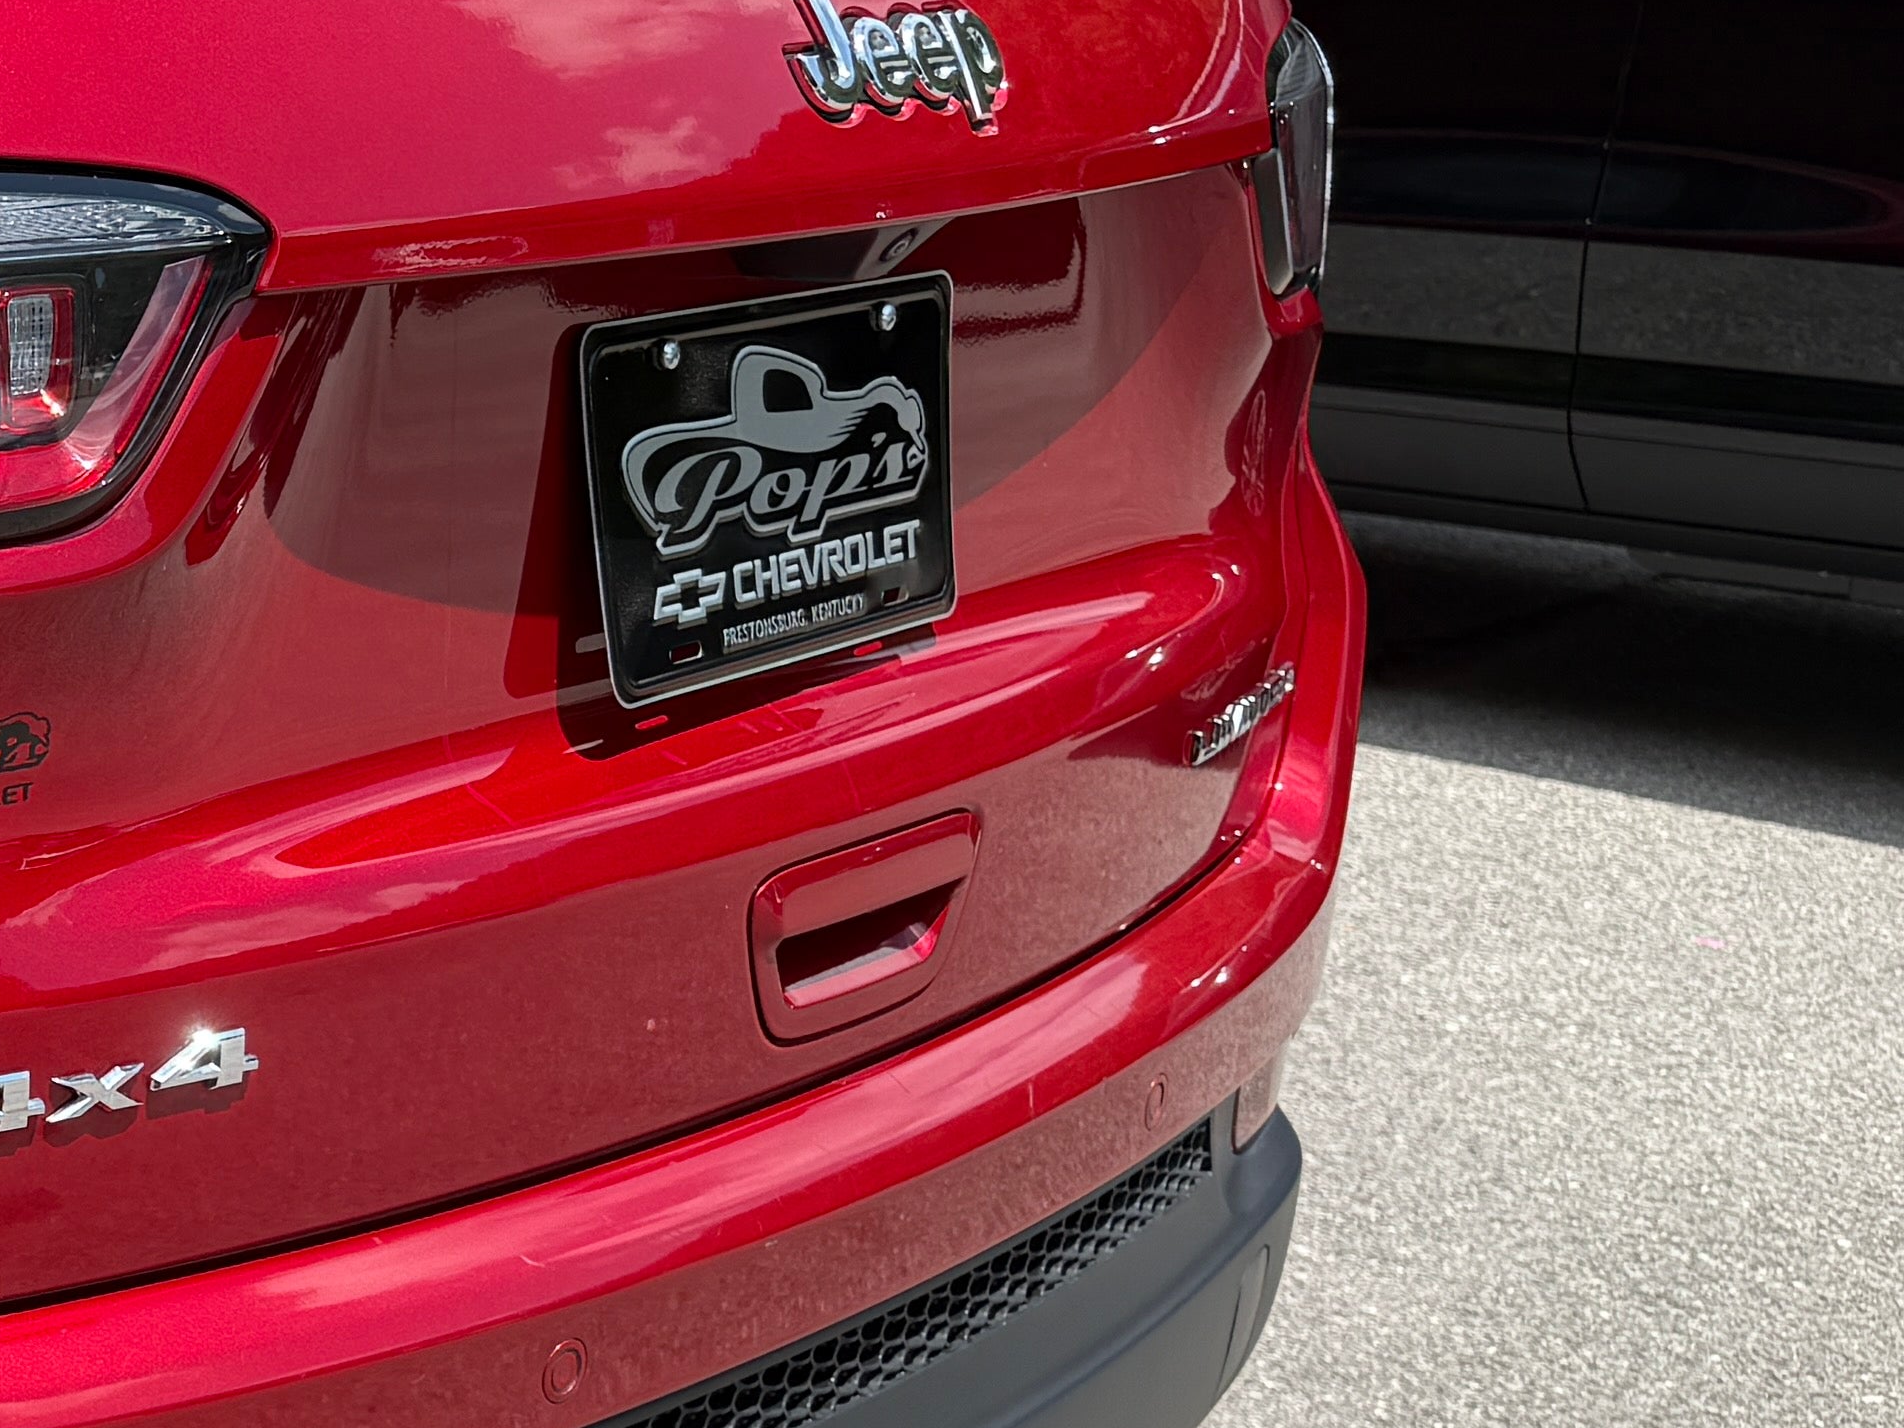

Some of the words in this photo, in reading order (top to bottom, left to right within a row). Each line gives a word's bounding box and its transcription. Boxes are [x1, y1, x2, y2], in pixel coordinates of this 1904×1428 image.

[653, 430, 924, 534] Pop's
[733, 518, 920, 606] CHEVROLET
[811, 592, 866, 624] KENTUCKY
